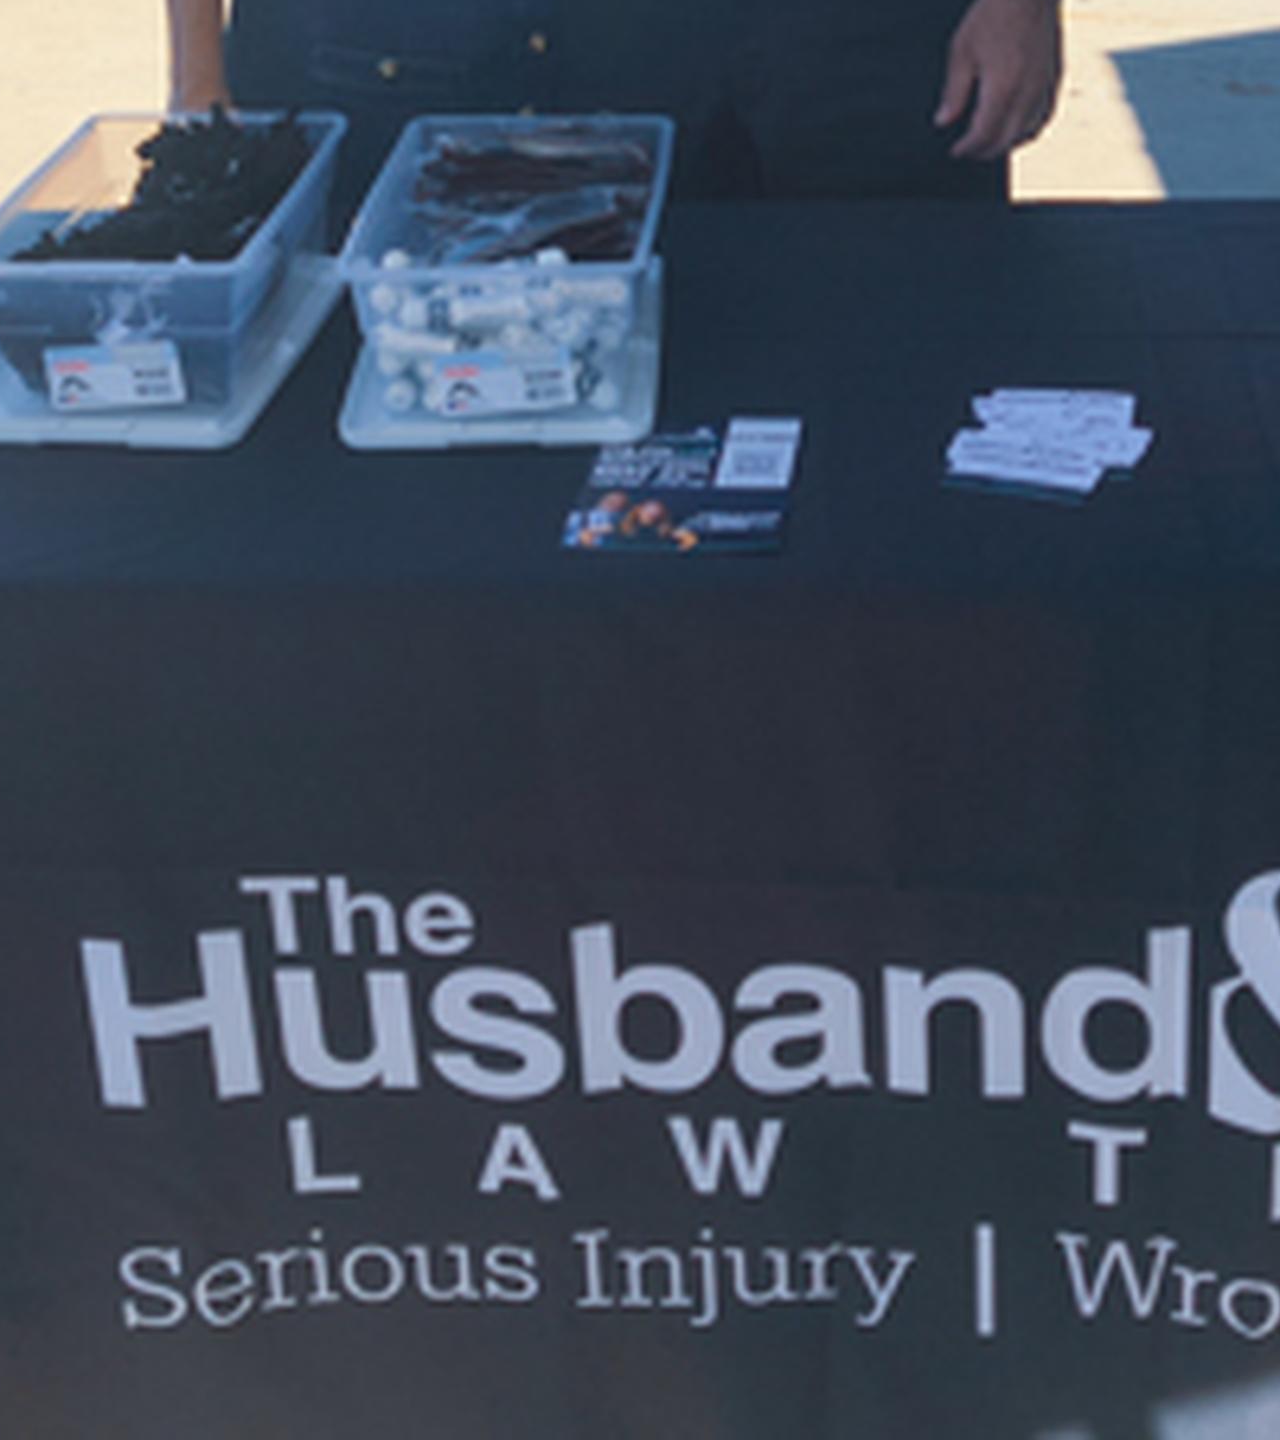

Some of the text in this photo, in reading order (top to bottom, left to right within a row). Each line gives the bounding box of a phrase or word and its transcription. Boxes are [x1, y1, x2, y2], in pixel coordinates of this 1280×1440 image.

[239, 875, 475, 956] The
[80, 924, 1191, 1109] Husband
[287, 1115, 783, 1200] LAW
[118, 1244, 540, 1329] Serious
[573, 1228, 914, 1326] Injury
